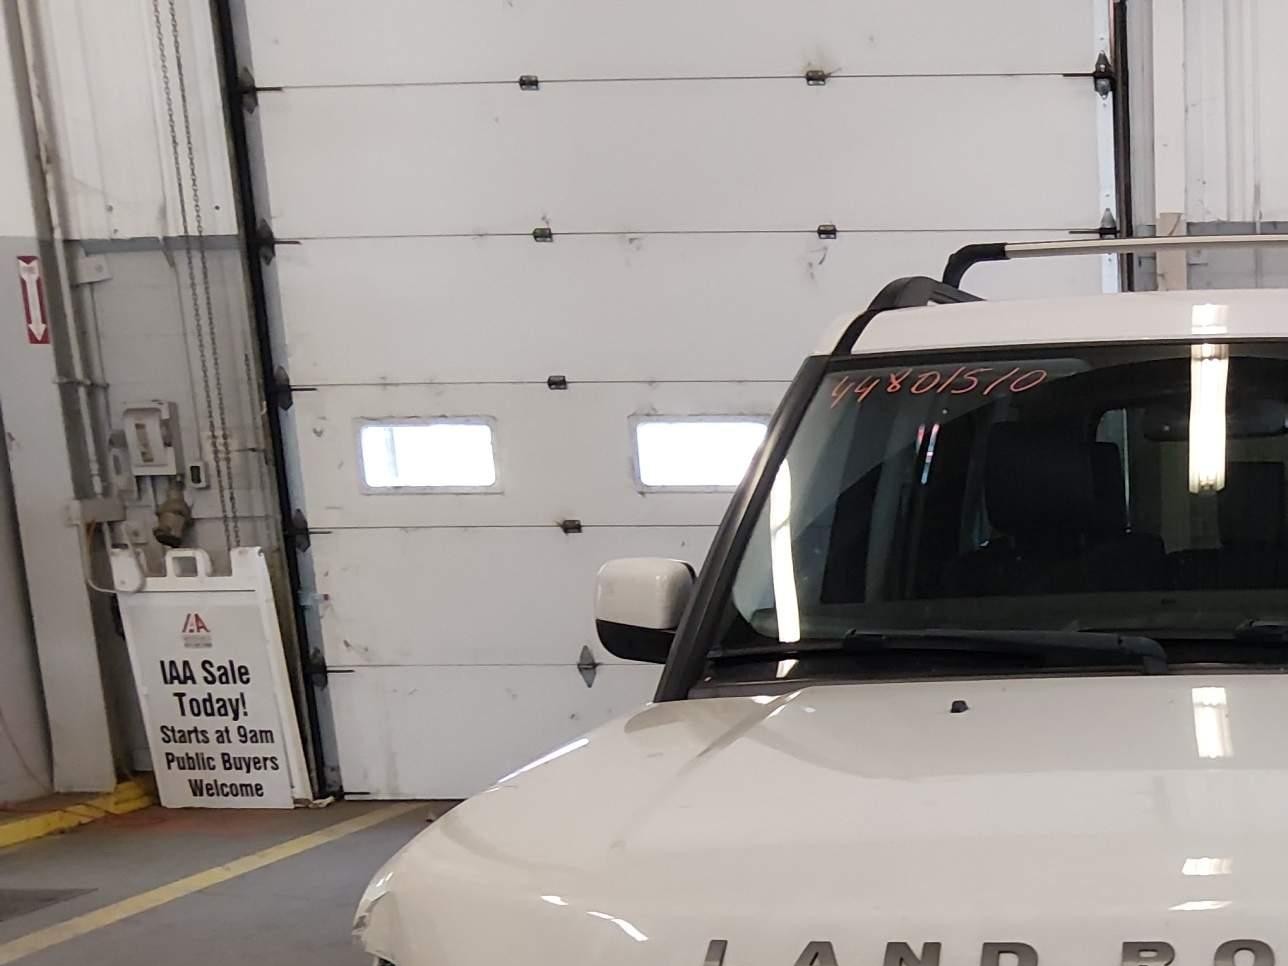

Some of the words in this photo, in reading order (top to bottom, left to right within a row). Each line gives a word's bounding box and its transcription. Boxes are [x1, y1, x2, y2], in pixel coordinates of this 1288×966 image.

[831, 367, 1048, 409] 44801510
[159, 659, 197, 685] IAA
[201, 659, 251, 685] Sale
[172, 692, 249, 722] Today!
[160, 725, 210, 744] Starts
[215, 726, 232, 744] at
[237, 725, 275, 744] 9am
[165, 752, 216, 771] Public
[221, 752, 280, 774] Buyers
[188, 779, 264, 797] Welcome
